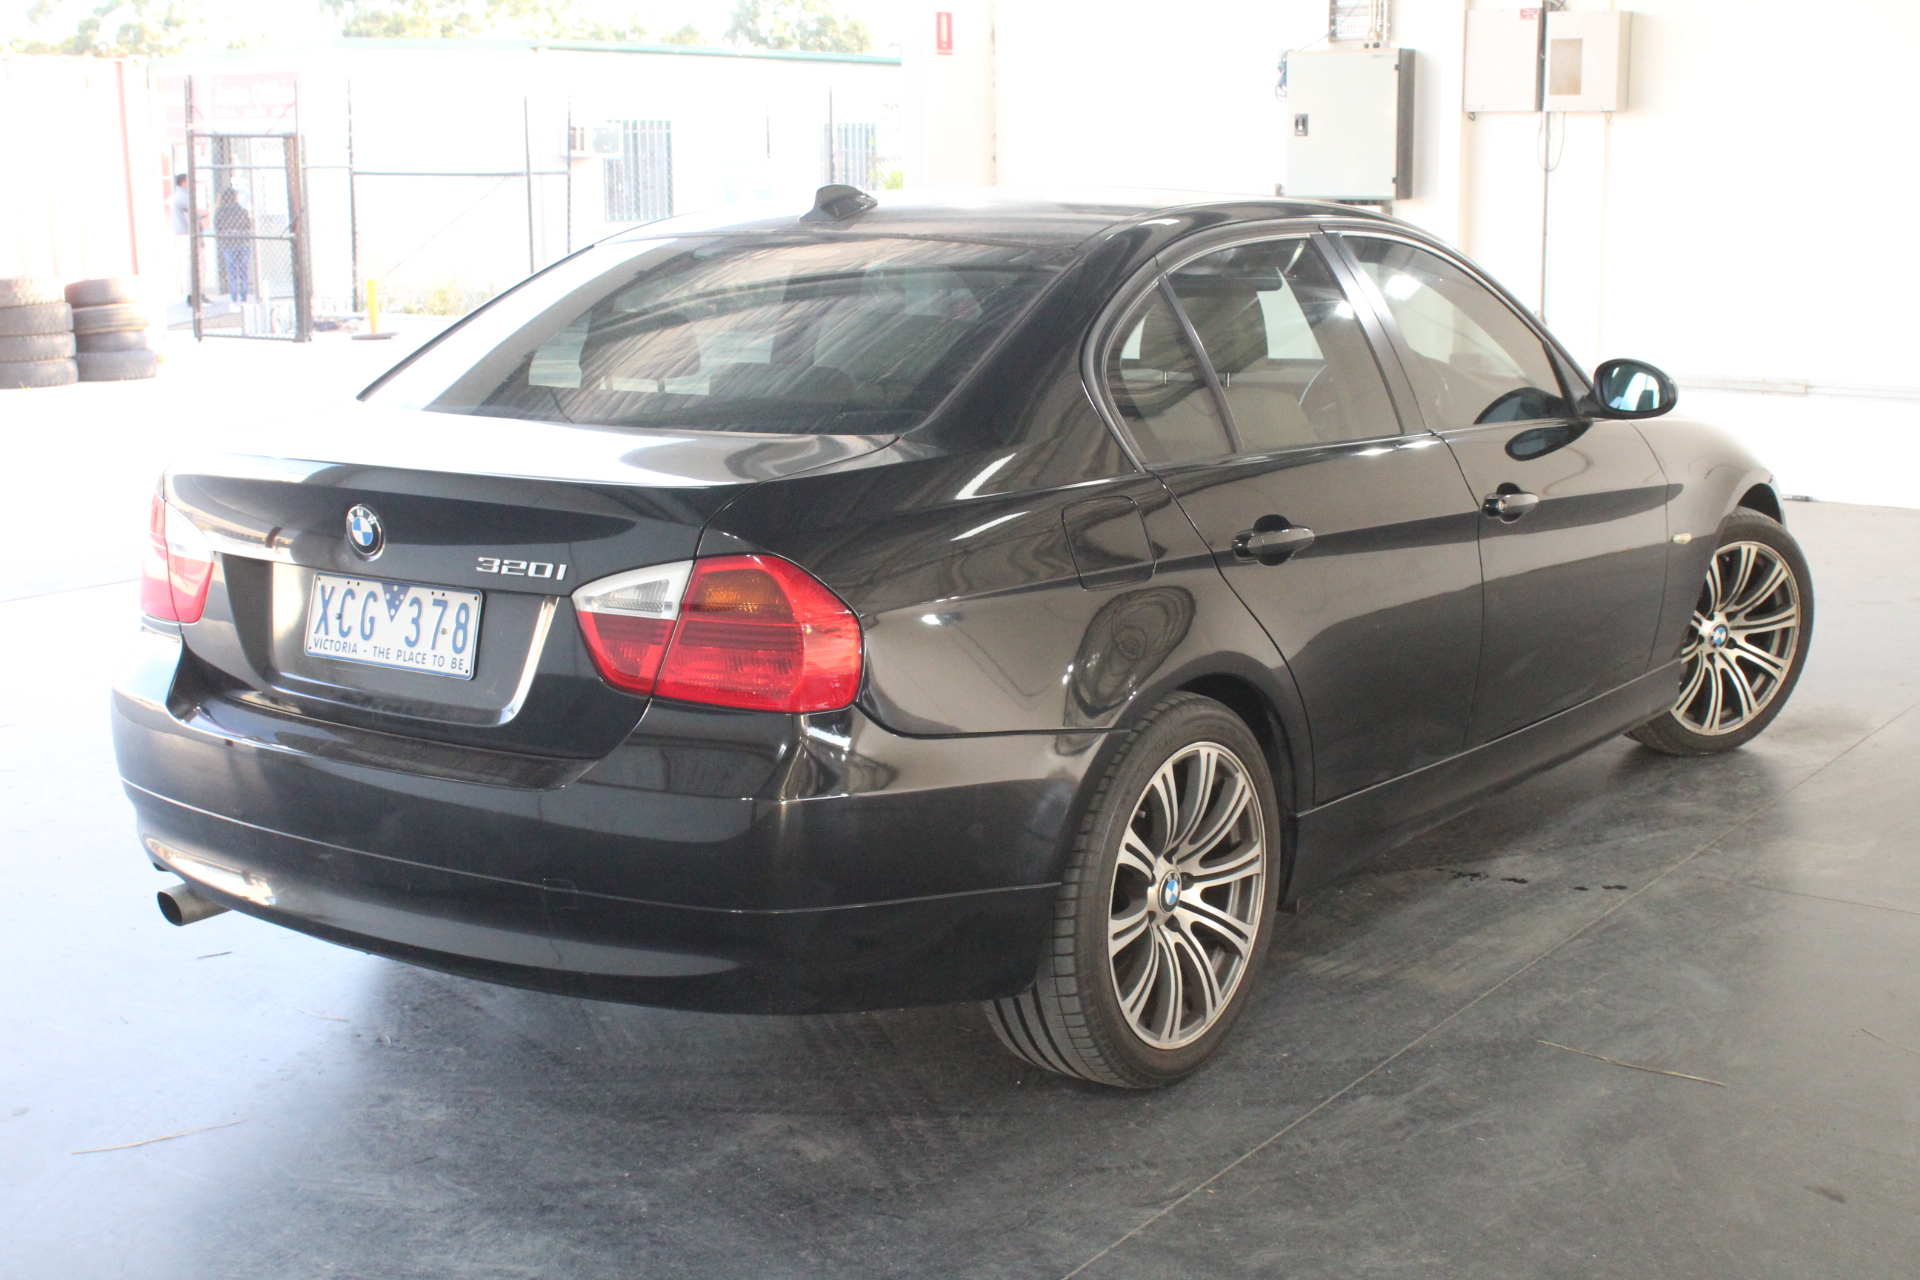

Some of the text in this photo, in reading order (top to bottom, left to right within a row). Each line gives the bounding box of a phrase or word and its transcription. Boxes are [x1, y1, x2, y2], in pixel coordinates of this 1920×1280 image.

[314, 584, 470, 655] XCG 378
[313, 637, 358, 655] VICTORIA
[373, 645, 391, 660] THE
[396, 649, 427, 665] PLACE
[432, 655, 445, 668] TO
[450, 657, 464, 671] BE
